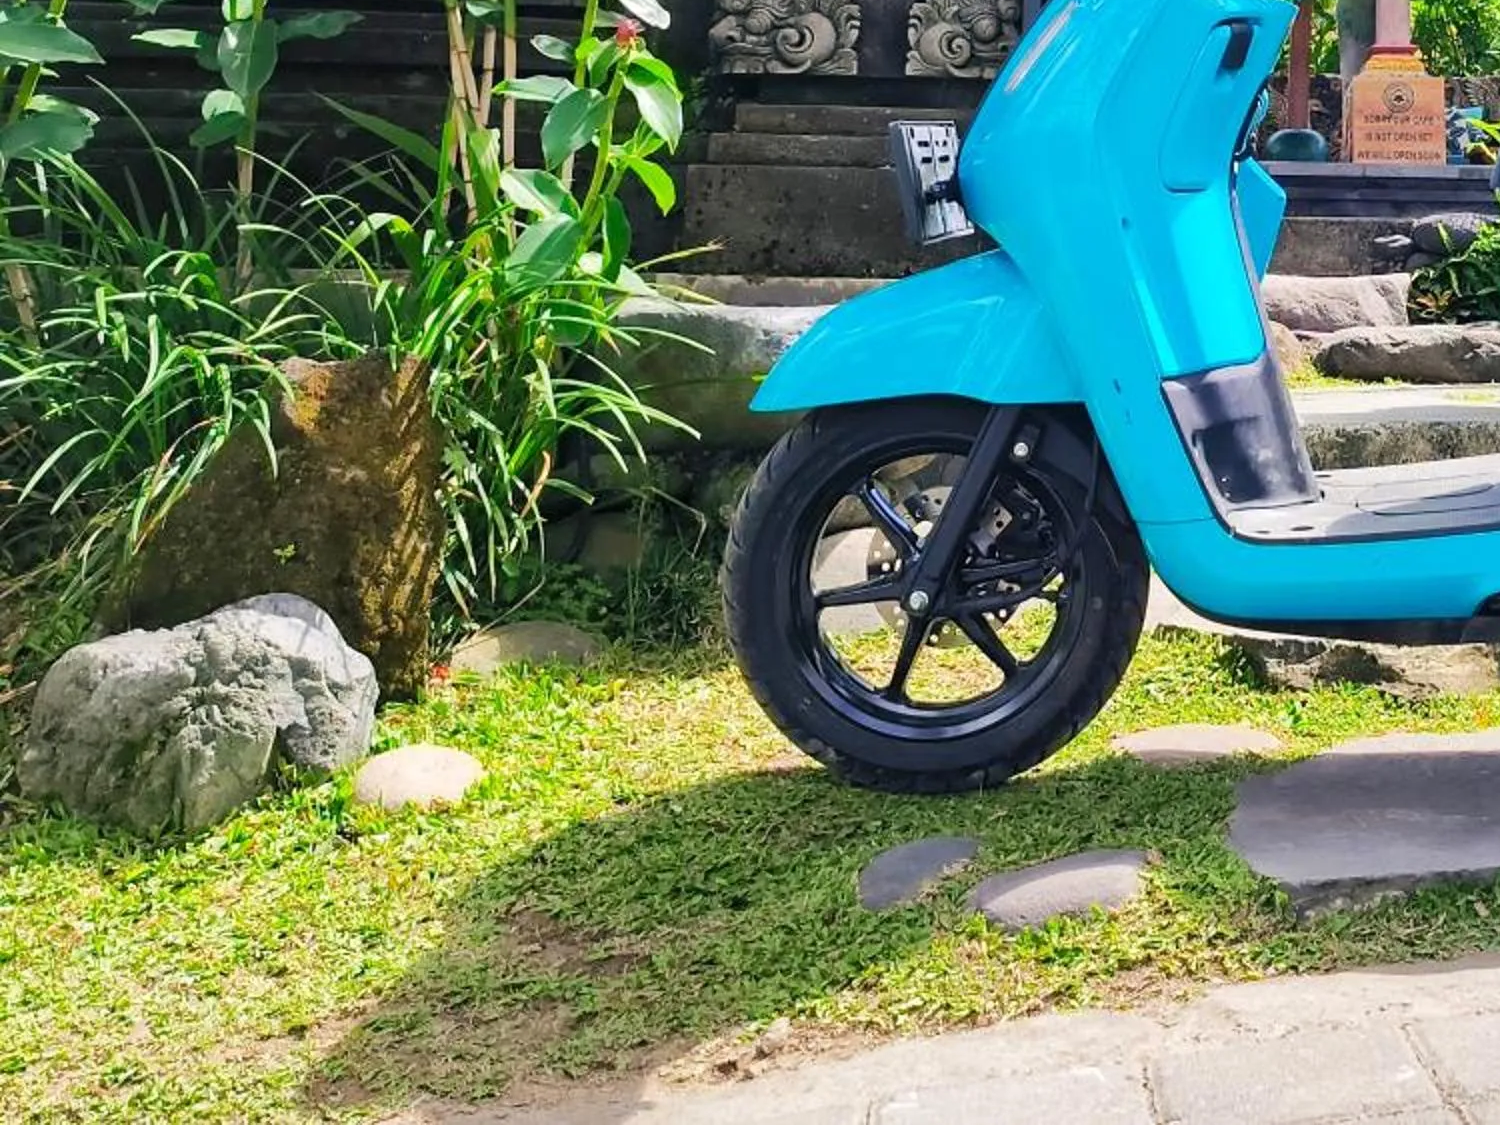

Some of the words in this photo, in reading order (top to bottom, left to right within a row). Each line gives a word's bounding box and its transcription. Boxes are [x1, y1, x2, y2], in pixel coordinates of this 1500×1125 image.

[1375, 132, 1391, 142] NOT
[1393, 132, 1417, 142] OPEN
[1393, 150, 1417, 161] OPEN
